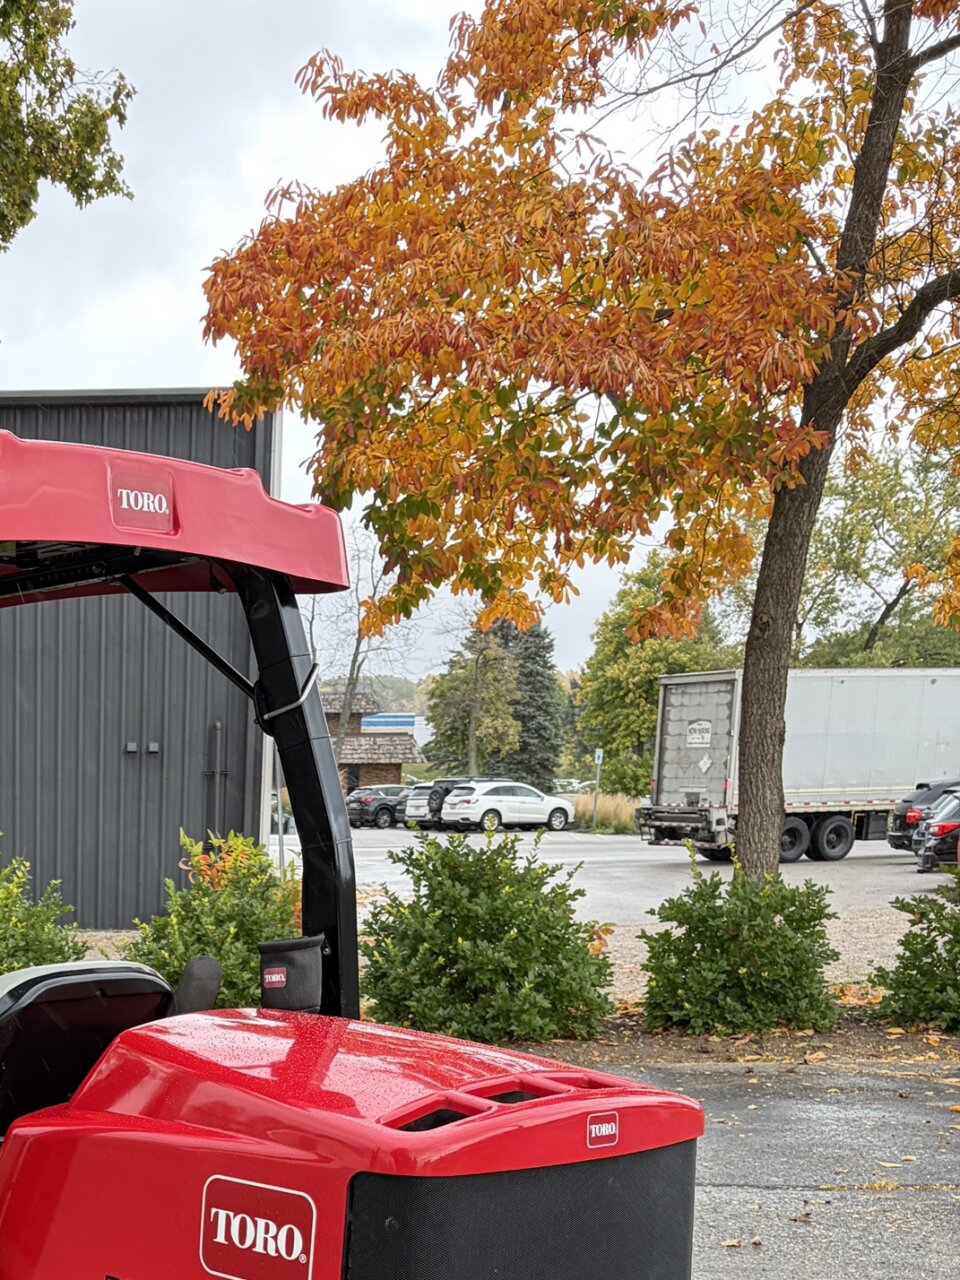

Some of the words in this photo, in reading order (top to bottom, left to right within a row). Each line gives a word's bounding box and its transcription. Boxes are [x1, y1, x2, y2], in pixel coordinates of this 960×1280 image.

[117, 488, 168, 514] TORO
[264, 974, 285, 982] TORO
[589, 1122, 616, 1137] TORO
[210, 1207, 305, 1262] TORO
